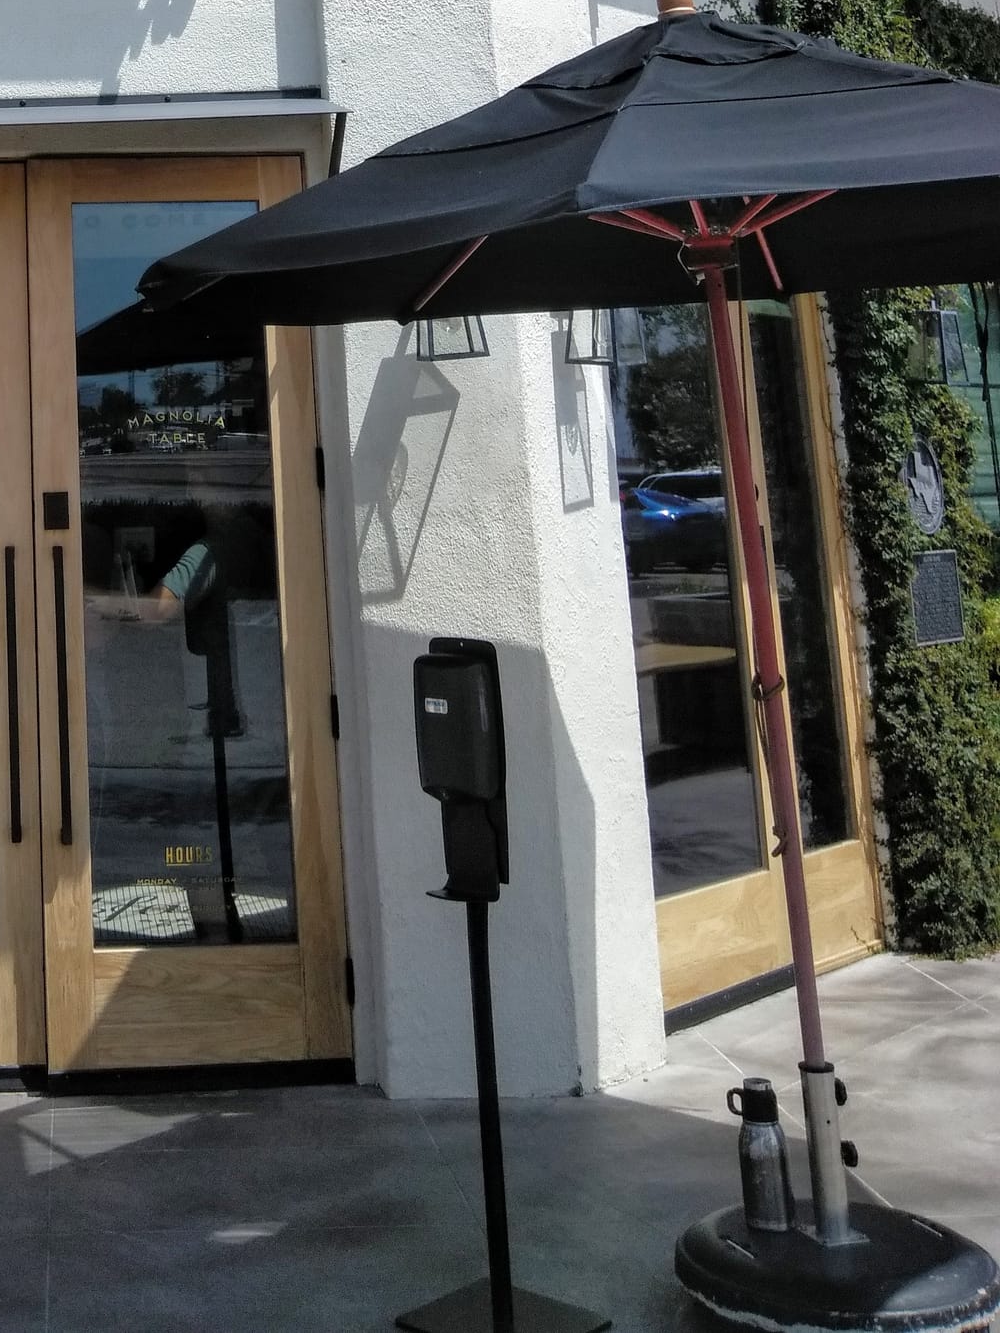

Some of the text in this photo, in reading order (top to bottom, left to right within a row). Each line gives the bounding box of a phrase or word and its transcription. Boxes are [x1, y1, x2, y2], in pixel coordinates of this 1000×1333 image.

[127, 410, 226, 429] MAGNOLIA
[150, 433, 206, 444] TABLE
[165, 846, 213, 864] HOURS
[136, 877, 177, 886] MONDAY
